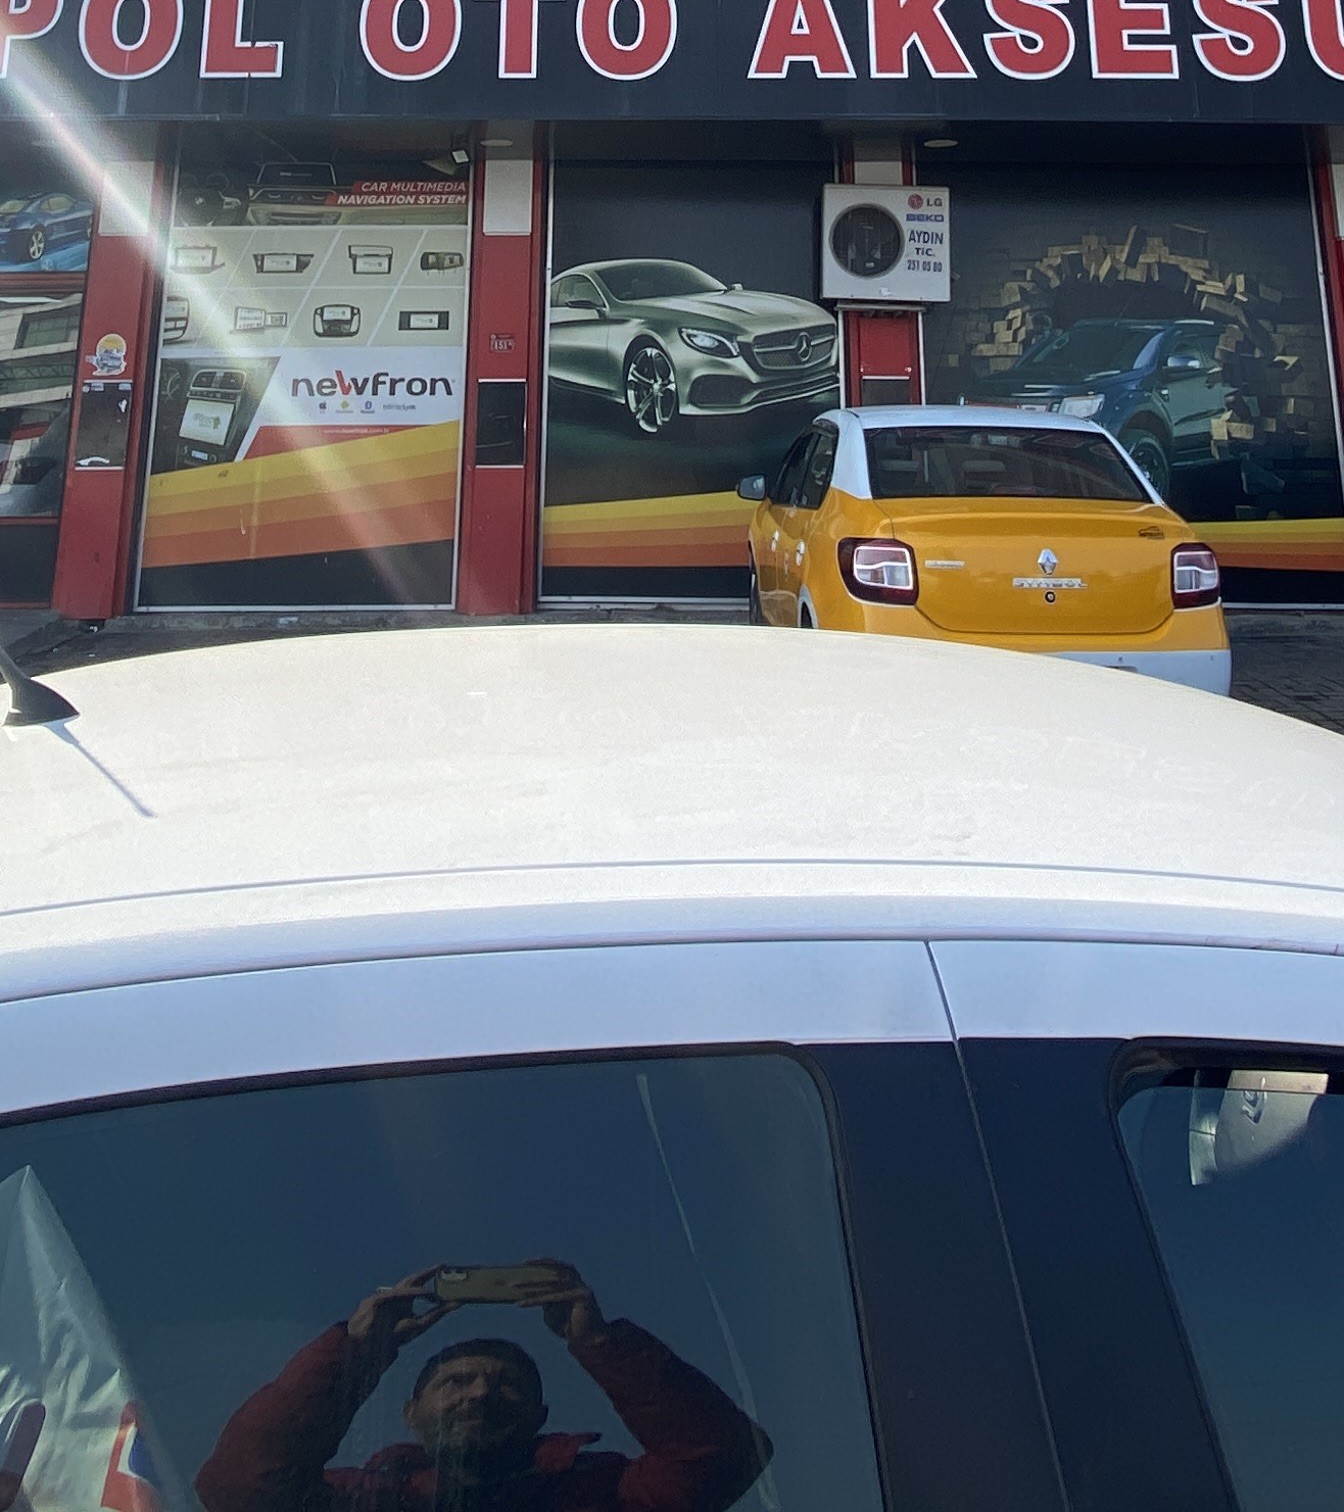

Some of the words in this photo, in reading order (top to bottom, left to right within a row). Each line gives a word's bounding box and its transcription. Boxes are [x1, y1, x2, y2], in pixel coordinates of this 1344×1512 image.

[361, 182, 387, 192] CAR
[390, 182, 466, 192] MULTIMEDIA
[337, 194, 415, 205] NAVIGATION
[417, 194, 467, 204] SYSTEM
[926, 198, 943, 207] LG
[906, 214, 944, 222] BEKO
[908, 229, 944, 245] AYDIN
